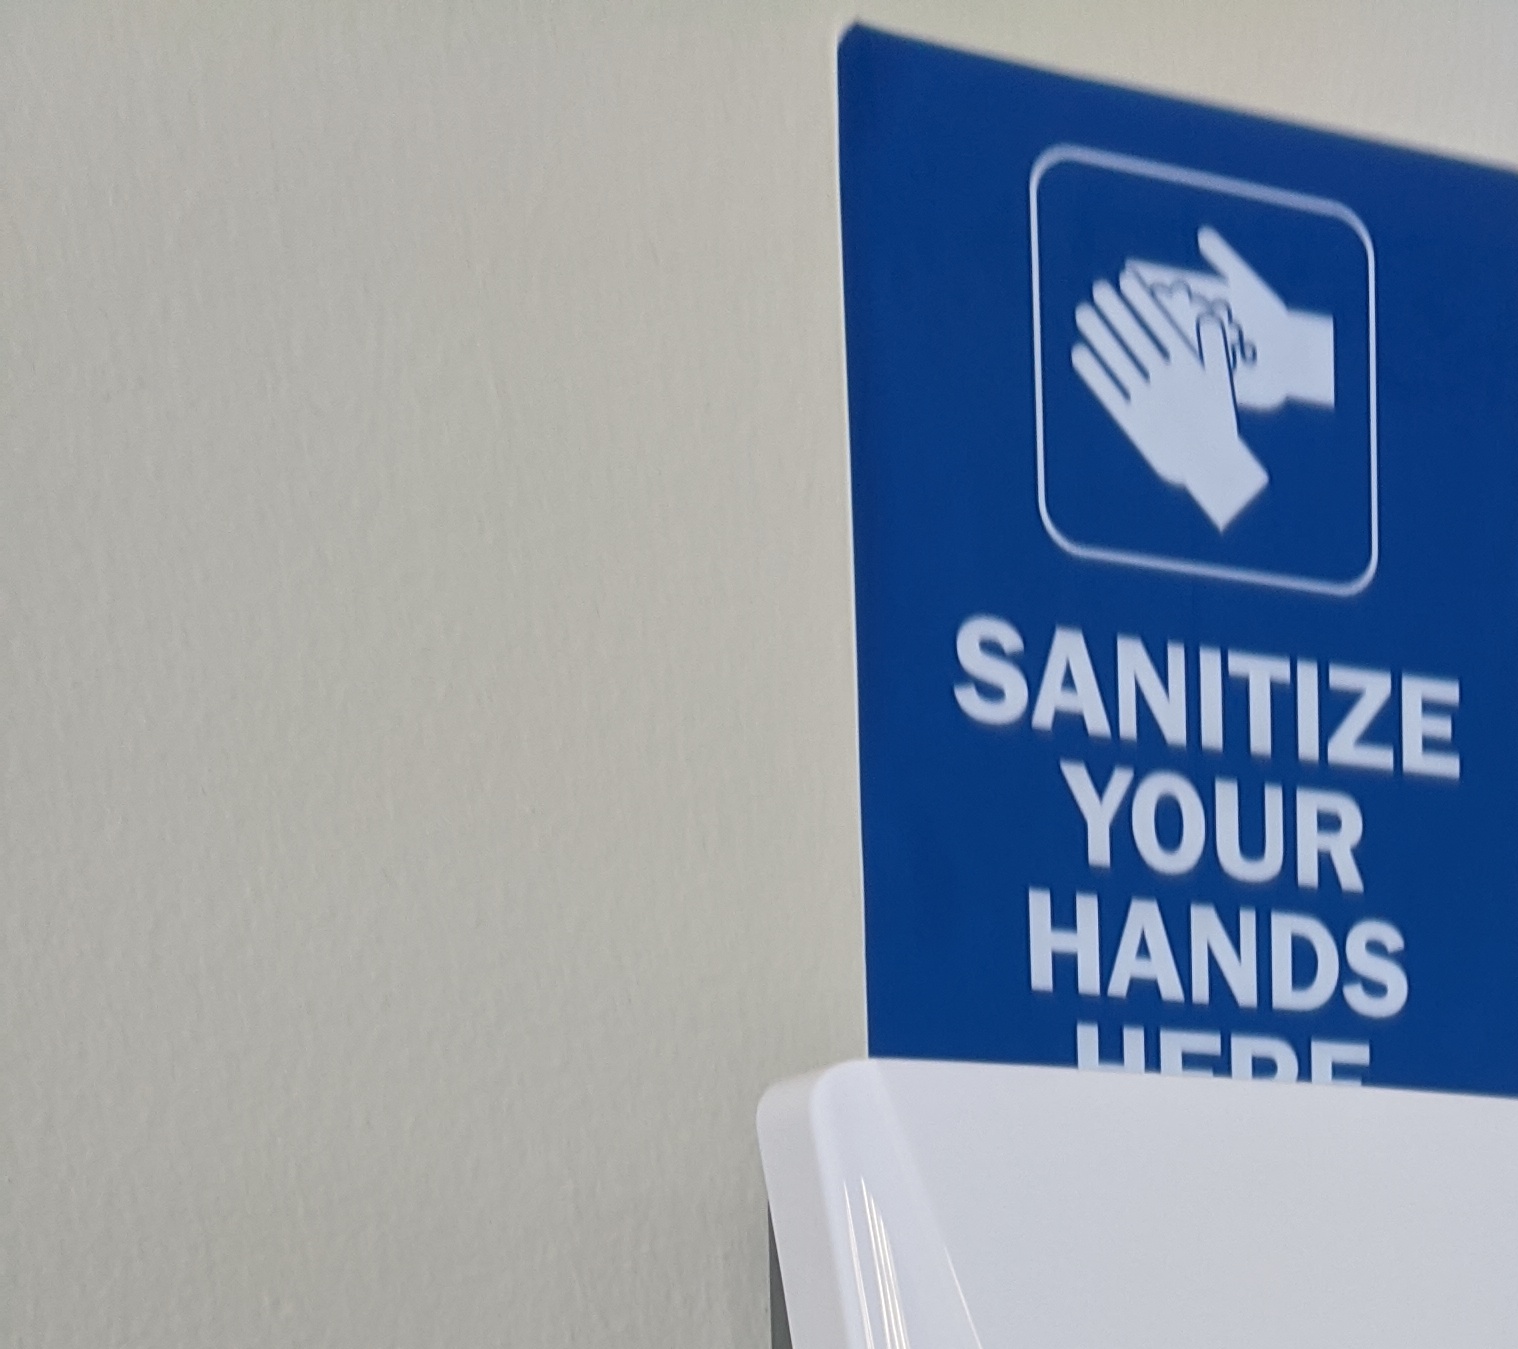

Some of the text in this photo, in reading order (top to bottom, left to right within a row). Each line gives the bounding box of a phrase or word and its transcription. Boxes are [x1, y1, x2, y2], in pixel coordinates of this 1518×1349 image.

[953, 615, 1461, 780] SANITIZE
[1060, 759, 1365, 893] YOUR
[1028, 887, 1410, 1020] HANDS
